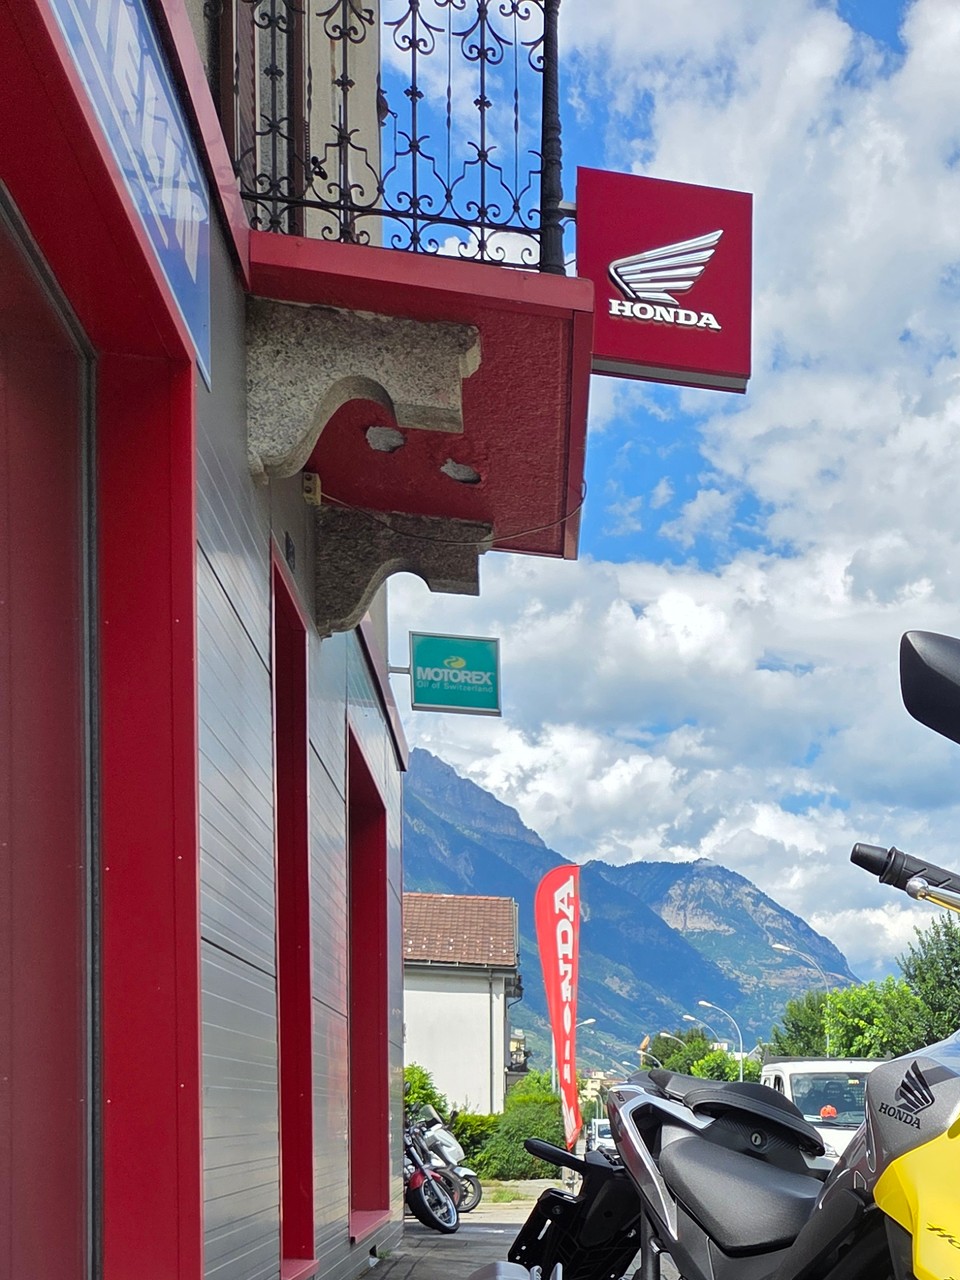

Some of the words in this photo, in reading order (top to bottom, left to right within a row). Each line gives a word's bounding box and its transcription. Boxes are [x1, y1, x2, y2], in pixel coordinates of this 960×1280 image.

[608, 298, 722, 330] HONDA
[416, 666, 493, 685] MOTOREX
[416, 680, 429, 688] Oil
[443, 682, 494, 693] Switzerland
[878, 1102, 921, 1130] HONDA
